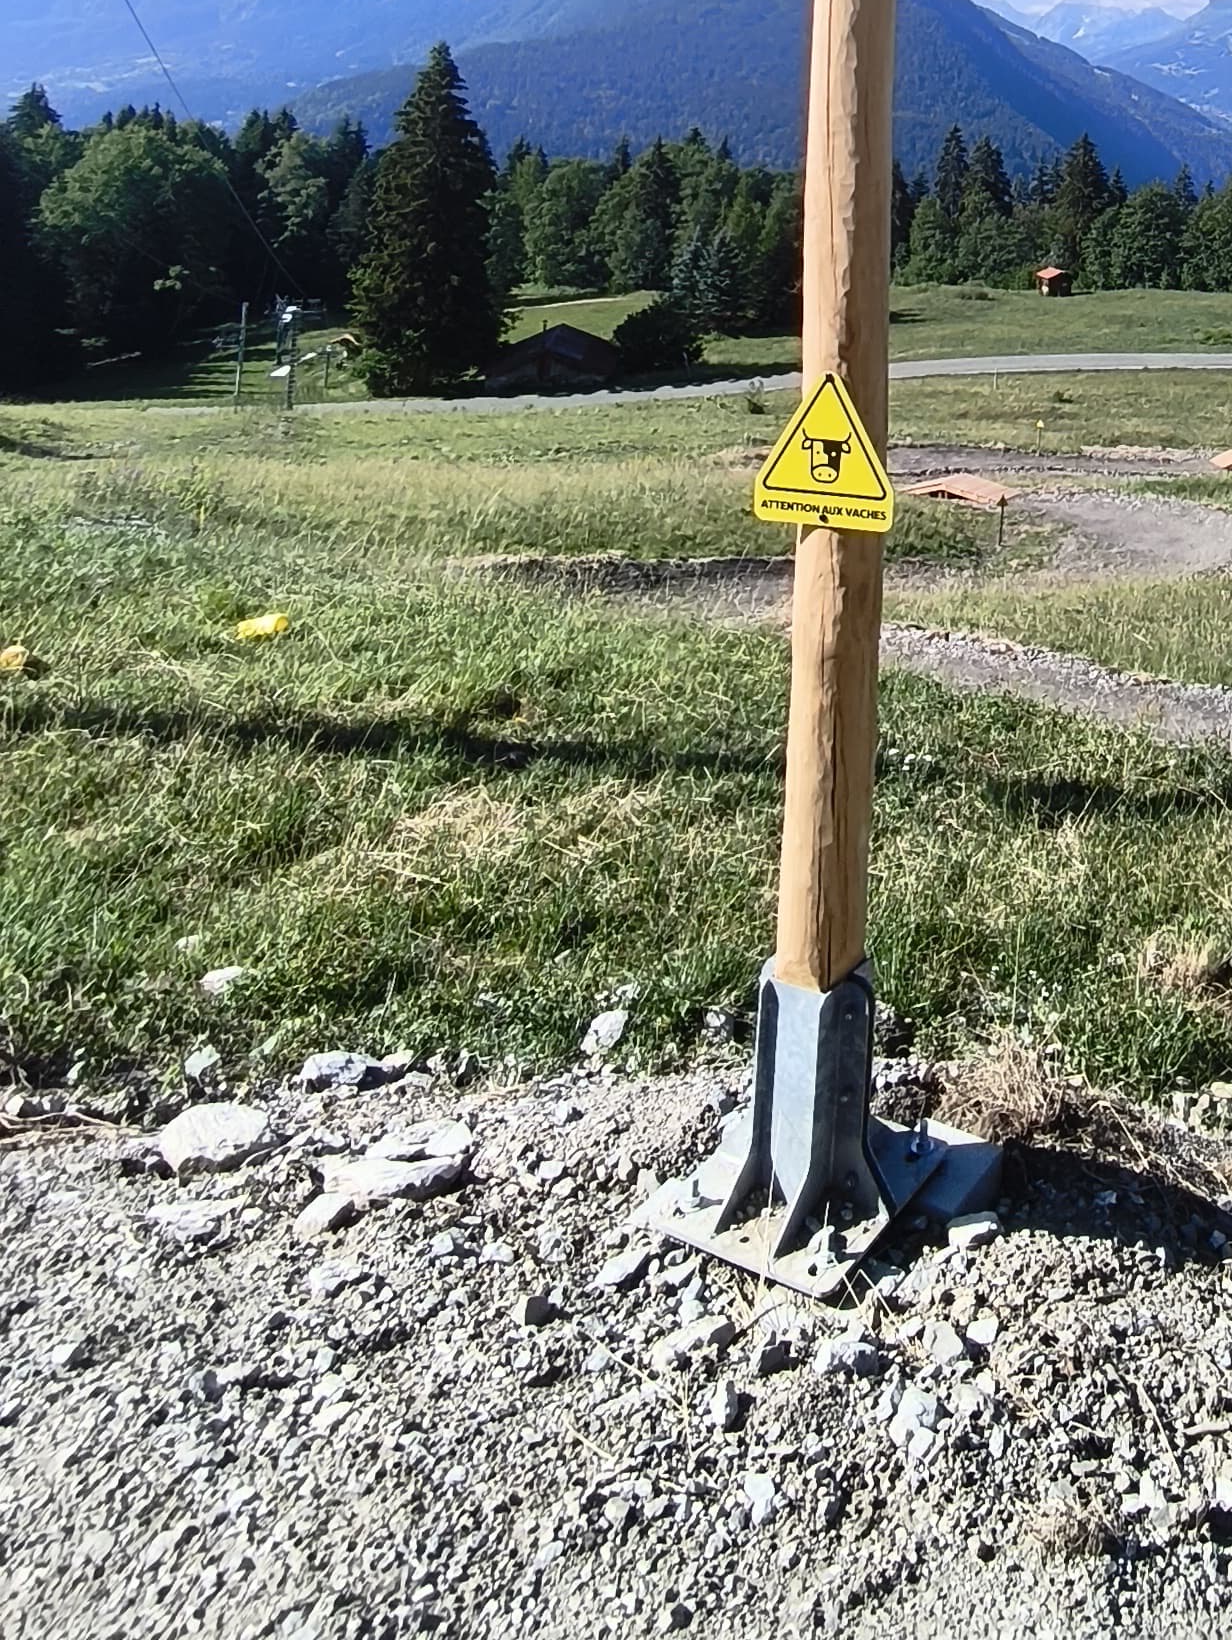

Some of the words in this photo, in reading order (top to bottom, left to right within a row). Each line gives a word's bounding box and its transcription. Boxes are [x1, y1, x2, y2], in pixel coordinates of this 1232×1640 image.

[761, 500, 820, 514] ATTENTION
[822, 505, 843, 516] AUX
[845, 508, 887, 521] VACHES
